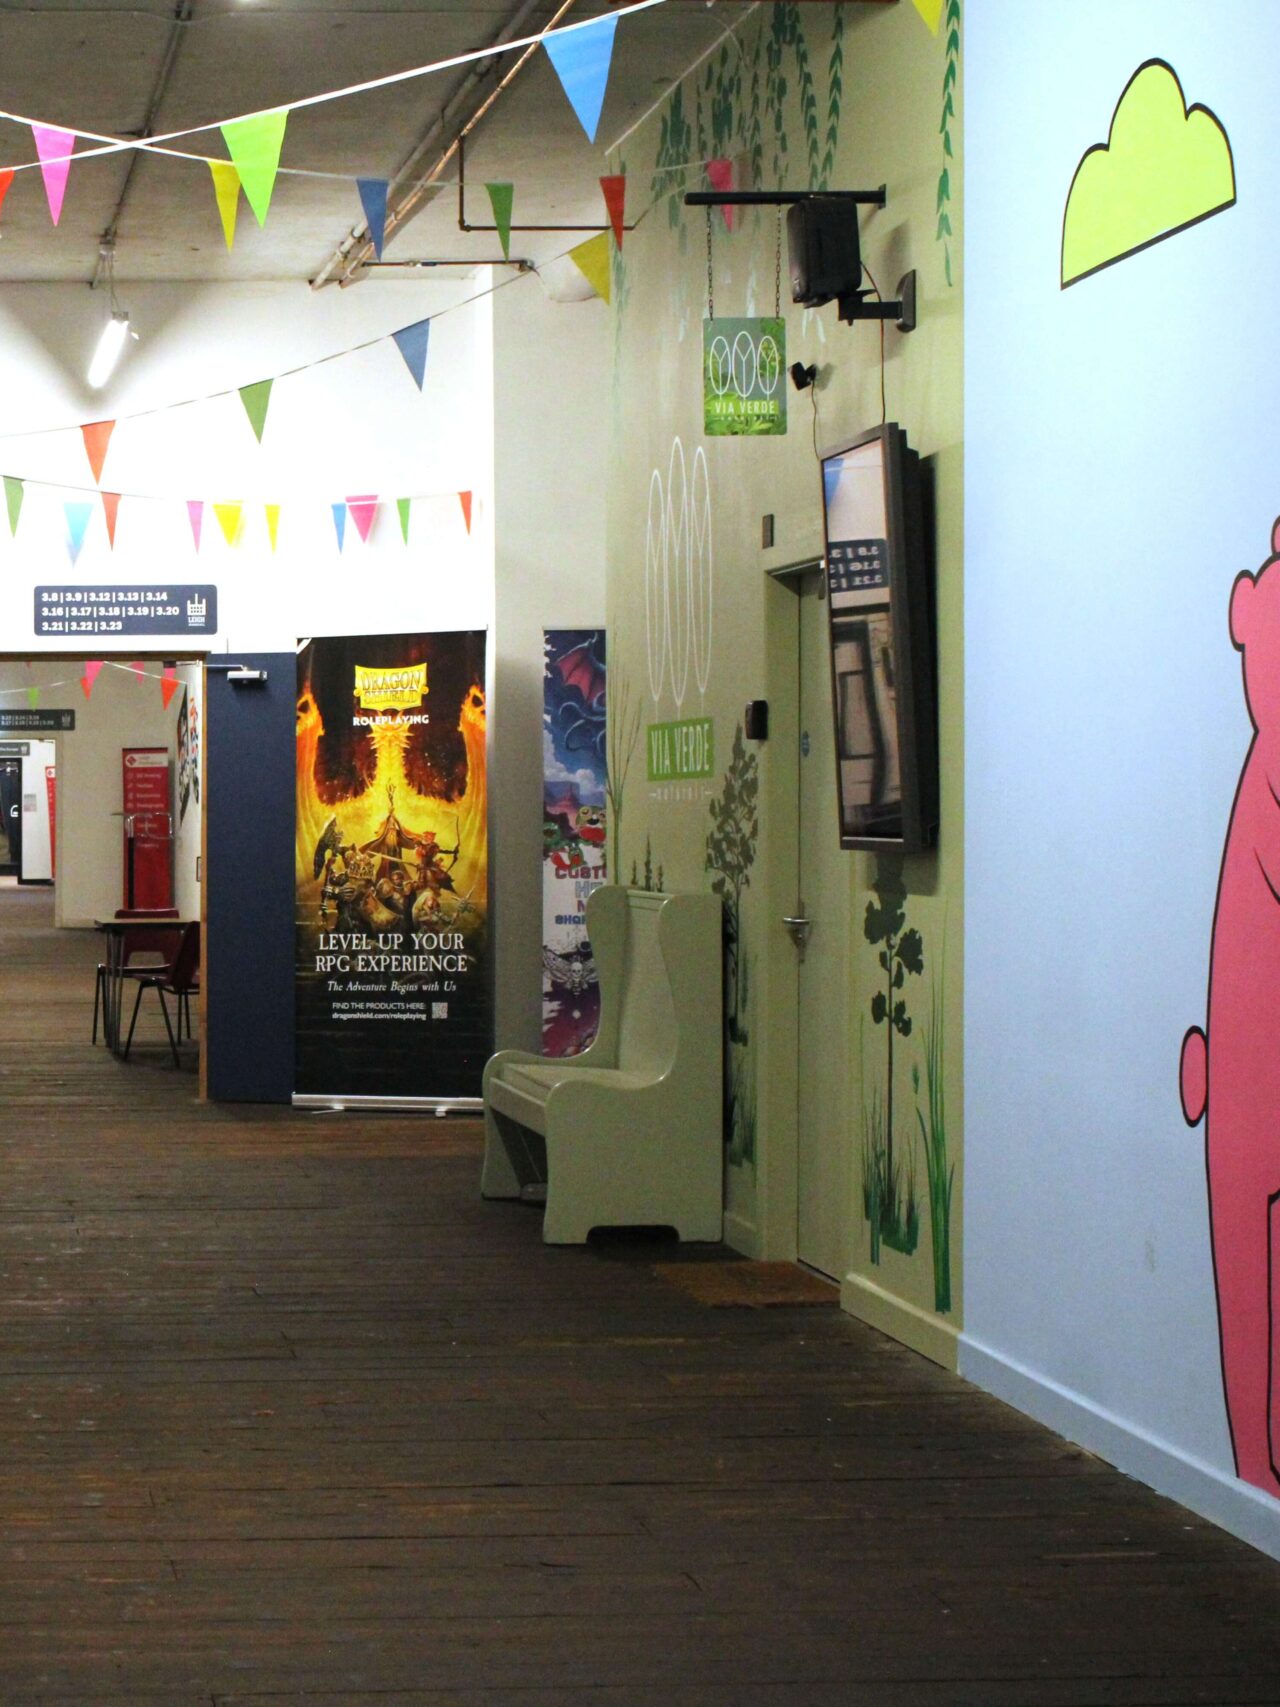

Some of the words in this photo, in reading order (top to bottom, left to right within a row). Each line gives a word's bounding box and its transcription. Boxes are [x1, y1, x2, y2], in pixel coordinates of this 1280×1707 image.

[715, 401, 734, 414] VIA
[740, 400, 775, 414] VERDE
[41, 592, 58, 602] 3.8
[65, 592, 82, 602] 3.9
[88, 592, 111, 601] 3.12
[117, 592, 139, 601] 3.13
[146, 591, 168, 601] 3.14
[41, 606, 64, 616] 3.16
[70, 606, 92, 616] 3.17
[98, 606, 120, 616] 3.18
[127, 606, 149, 616] 3.19
[156, 606, 180, 616] 3.20
[41, 621, 64, 631] 3.21
[70, 621, 93, 631] 3.22
[100, 621, 122, 631] 3.23
[360, 670, 422, 691] DRAGON
[352, 714, 429, 727] ROLEPLAYING
[651, 729, 671, 775] VIA
[674, 723, 709, 773] VERDE
[319, 933, 372, 950] LEVEL
[378, 933, 403, 950] UP
[411, 933, 464, 950] YOUR
[315, 955, 350, 972] RPG
[357, 955, 468, 972] EXPERIENCE
[327, 980, 343, 991] The
[346, 981, 387, 991] Adventure
[390, 981, 418, 995] Begins
[422, 981, 439, 991] with
[444, 982, 456, 991] Us
[332, 1002, 349, 1010] FIND
[350, 1002, 365, 1010] THE
[332, 1012, 427, 1021] dragonshield.com/roleplaying
